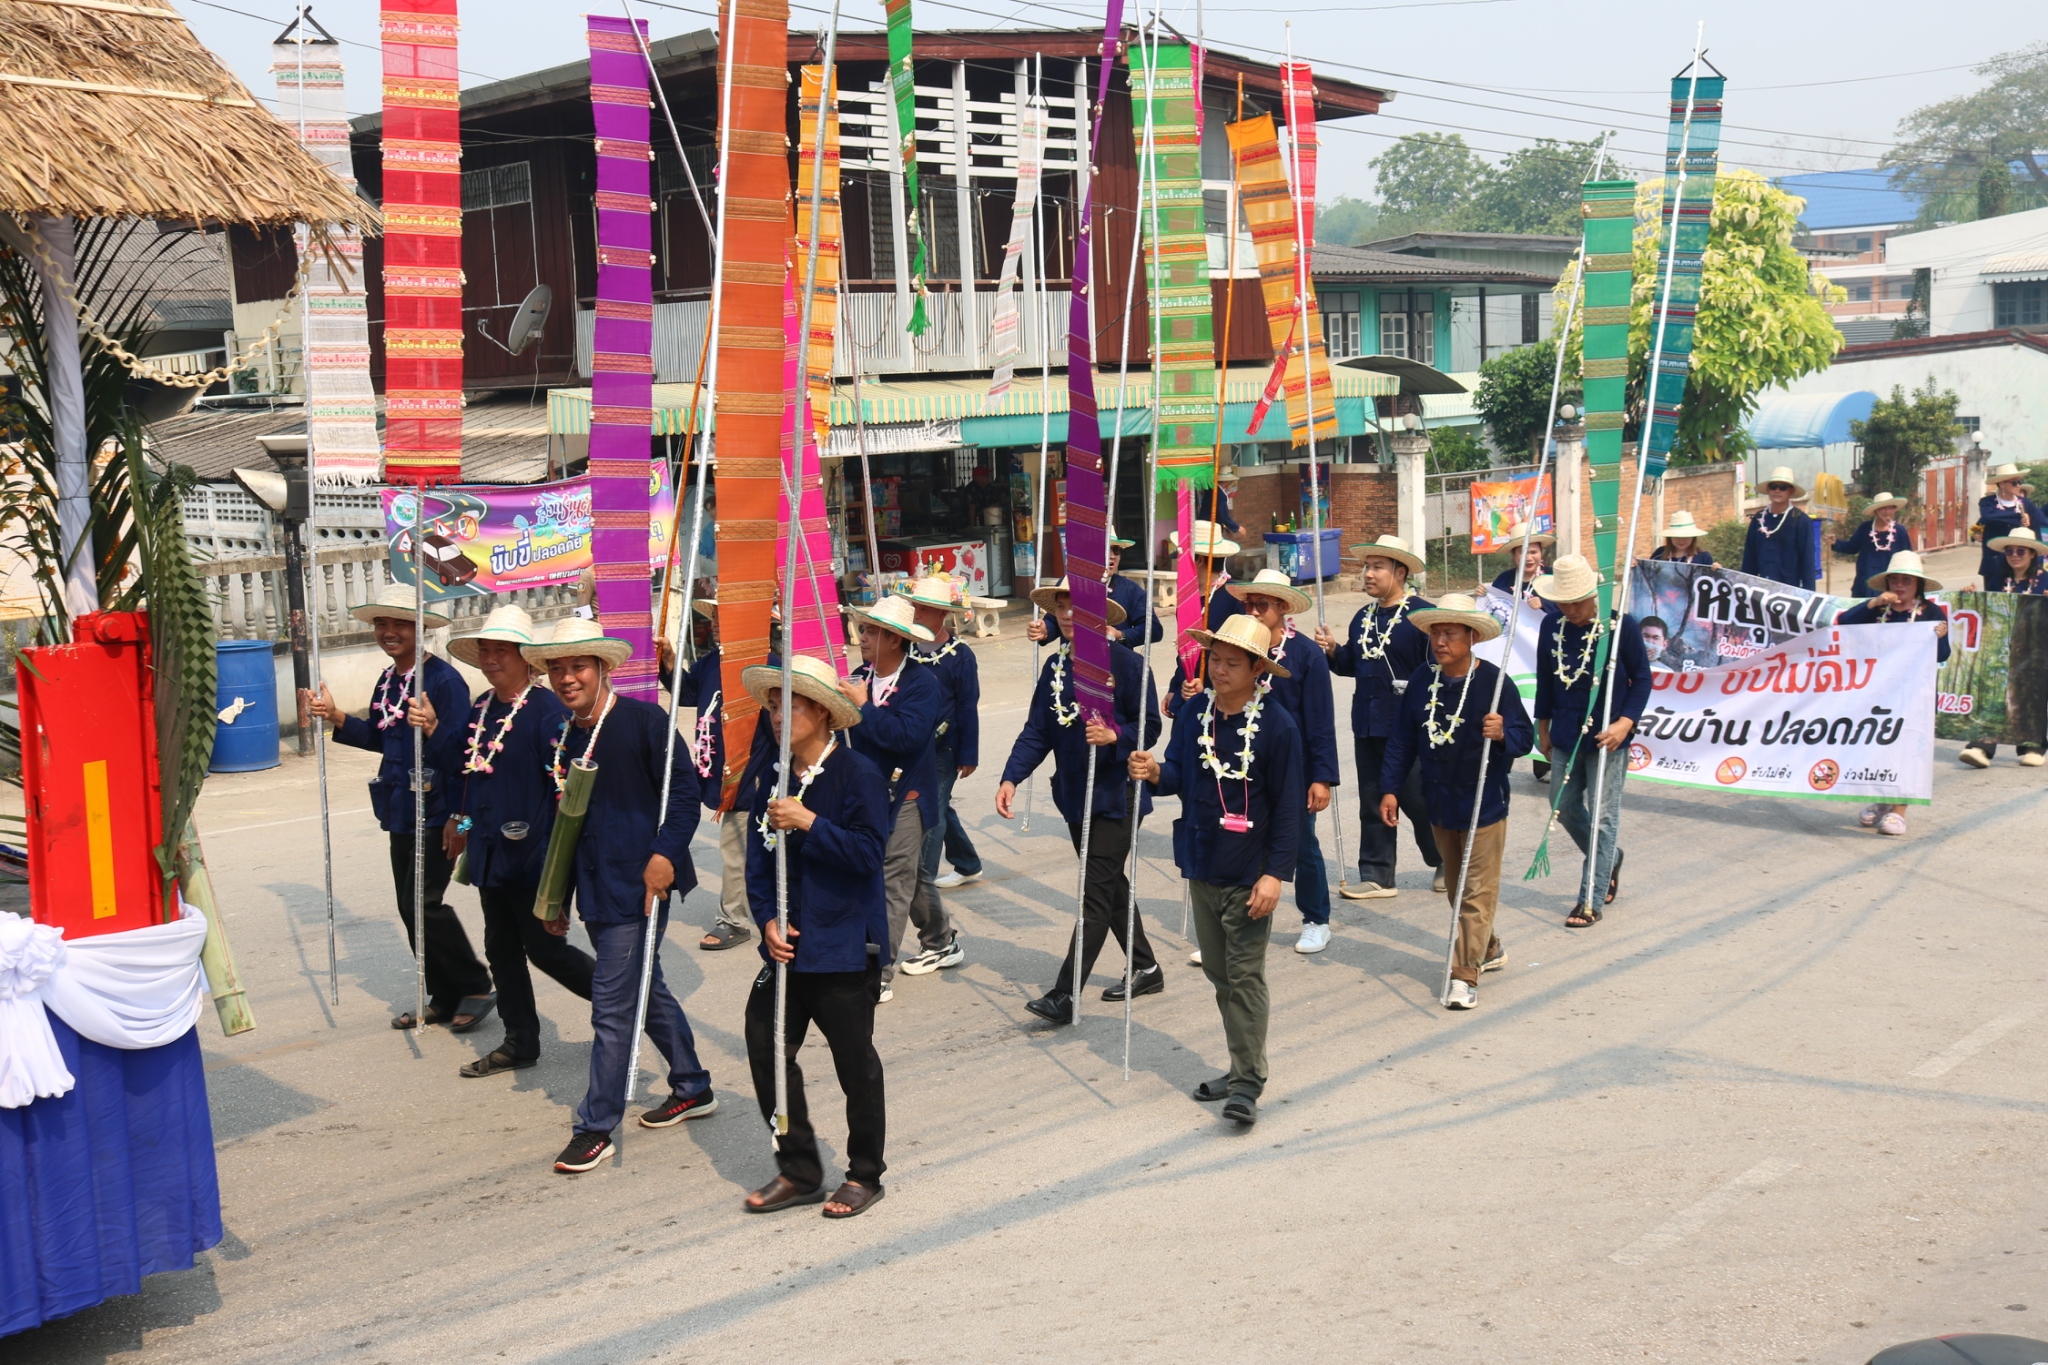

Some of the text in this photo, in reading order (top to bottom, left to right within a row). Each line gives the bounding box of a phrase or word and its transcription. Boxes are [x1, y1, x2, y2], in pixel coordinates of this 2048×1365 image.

[1695, 576, 1823, 646] หยุด!
[1759, 706, 1904, 746] ปลอดภัย
